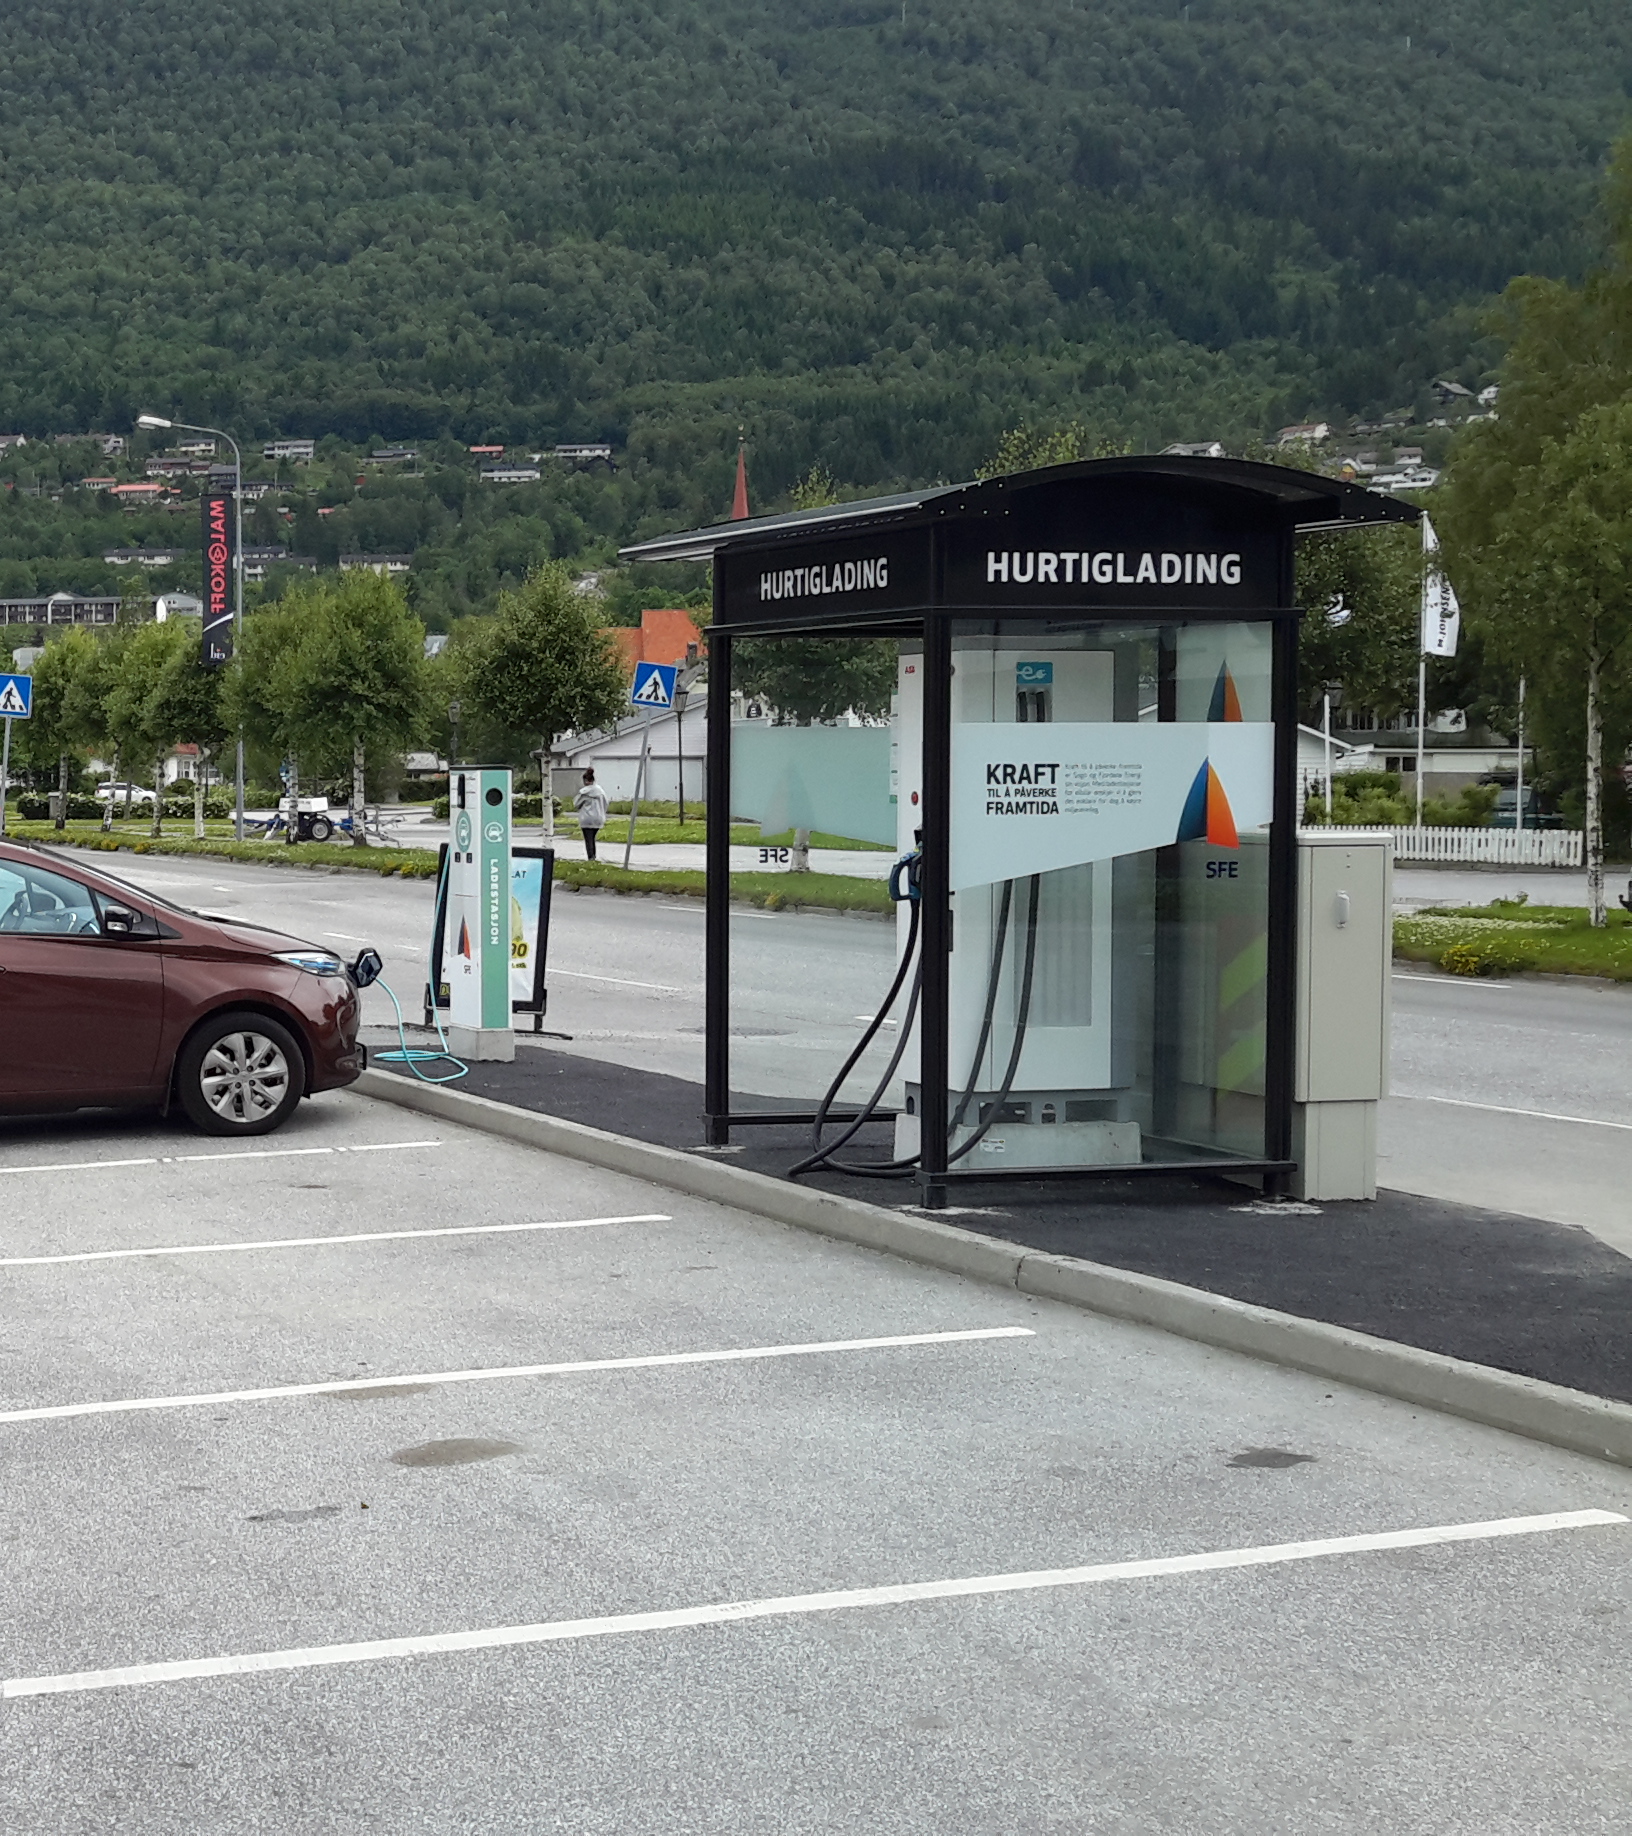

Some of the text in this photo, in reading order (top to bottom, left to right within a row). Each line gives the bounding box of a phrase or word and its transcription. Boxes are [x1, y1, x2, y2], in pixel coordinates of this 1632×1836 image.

[760, 557, 888, 601] HURTIGLADING
[986, 551, 1242, 585] HURTIGLADING
[986, 763, 1060, 785] KRAFT
[987, 788, 1001, 798] TIL
[1004, 786, 1011, 798] Å
[1014, 786, 1057, 797] PÅVERKE
[986, 801, 1060, 815] FRAMTIDA
[1206, 861, 1239, 879] SFE
[490, 858, 499, 945] LADESTASJON
